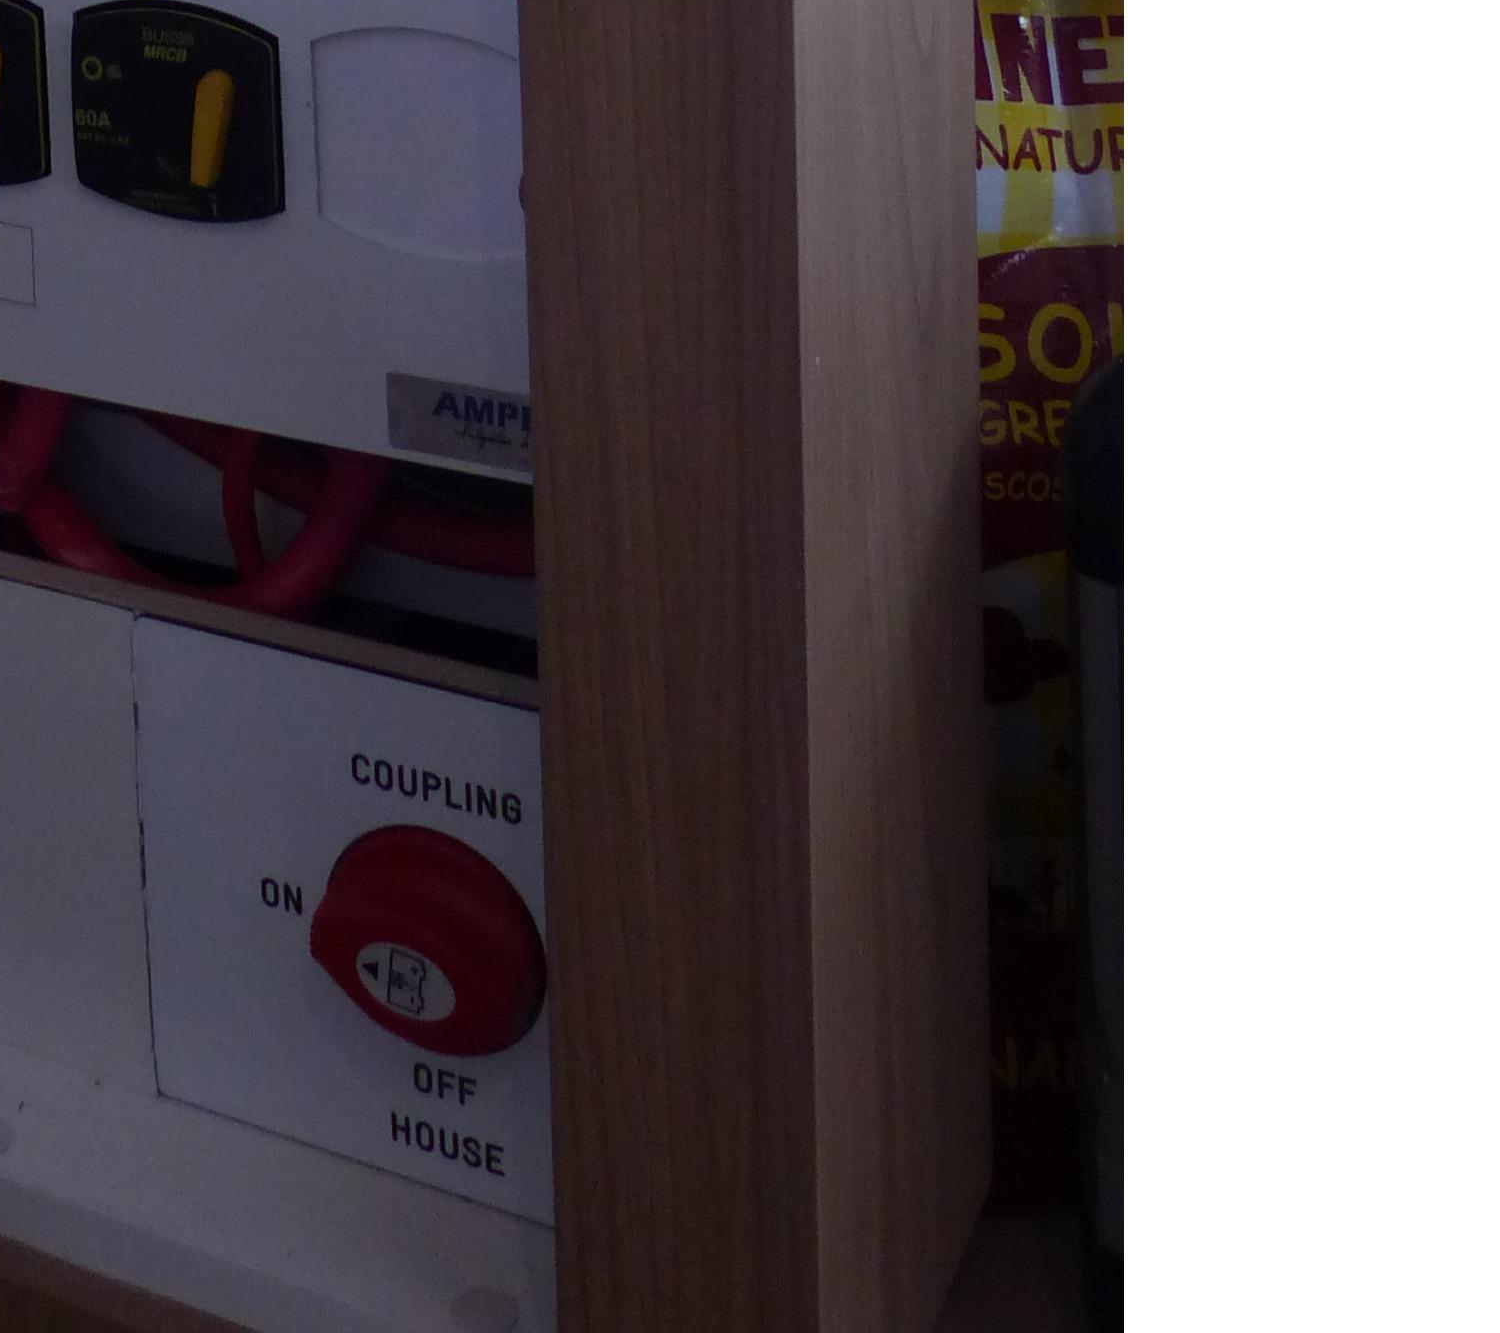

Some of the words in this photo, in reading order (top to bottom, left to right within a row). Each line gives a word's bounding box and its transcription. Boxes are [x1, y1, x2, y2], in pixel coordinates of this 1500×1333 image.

[143, 43, 187, 64] MRCB
[351, 753, 522, 824] COUPLING
[261, 877, 303, 915] ON
[413, 1063, 478, 1106] OFF
[391, 1111, 505, 1177] HOUSE
